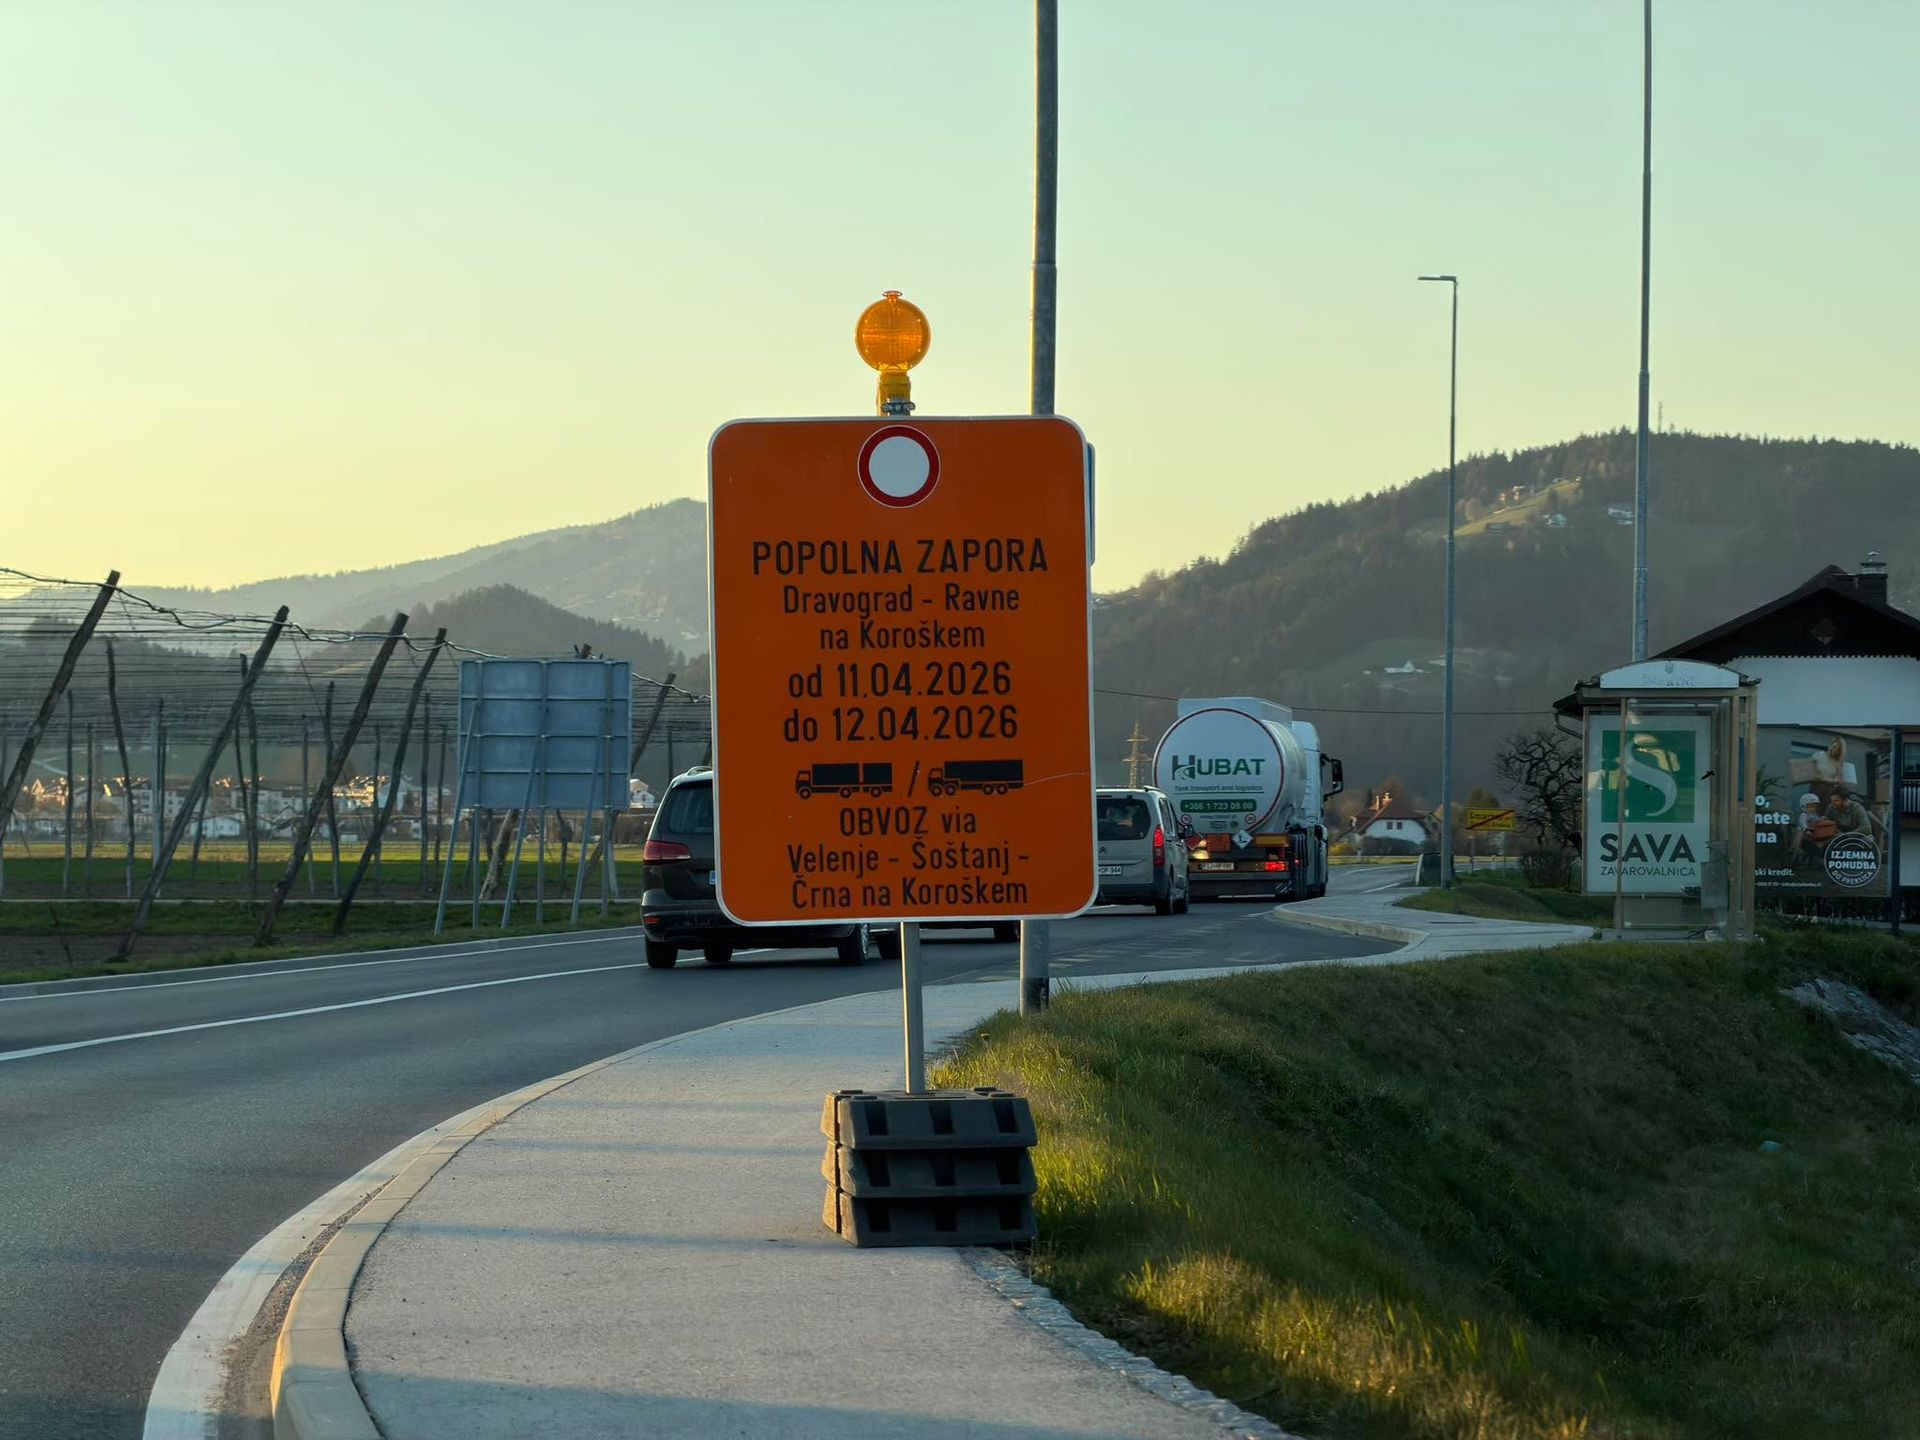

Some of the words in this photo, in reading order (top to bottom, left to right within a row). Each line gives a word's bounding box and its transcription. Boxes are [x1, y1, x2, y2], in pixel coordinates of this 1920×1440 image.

[752, 538, 903, 577] POPOLNA
[916, 537, 1049, 574] ZAPORA
[783, 582, 913, 620] Dravograd
[944, 582, 1020, 612] Ravne
[819, 628, 850, 651] na
[859, 619, 986, 649] Koroškem
[788, 664, 823, 699] od
[836, 660, 1012, 699] 11.04.2026
[783, 709, 819, 743] do
[832, 704, 1019, 742] 12.04.2026
[1172, 754, 1266, 781] HUBAT
[839, 806, 929, 837] OBVOZ
[940, 805, 977, 834] via
[787, 843, 879, 880] Velenje
[911, 835, 1010, 877] Šoštanj
[1600, 833, 1696, 863] SAVA
[1830, 850, 1875, 860] IZJEMNA
[1828, 860, 1877, 870] PONUDBA
[791, 874, 851, 909] Črna
[862, 884, 892, 907] na
[901, 874, 1028, 907] Koroškem
